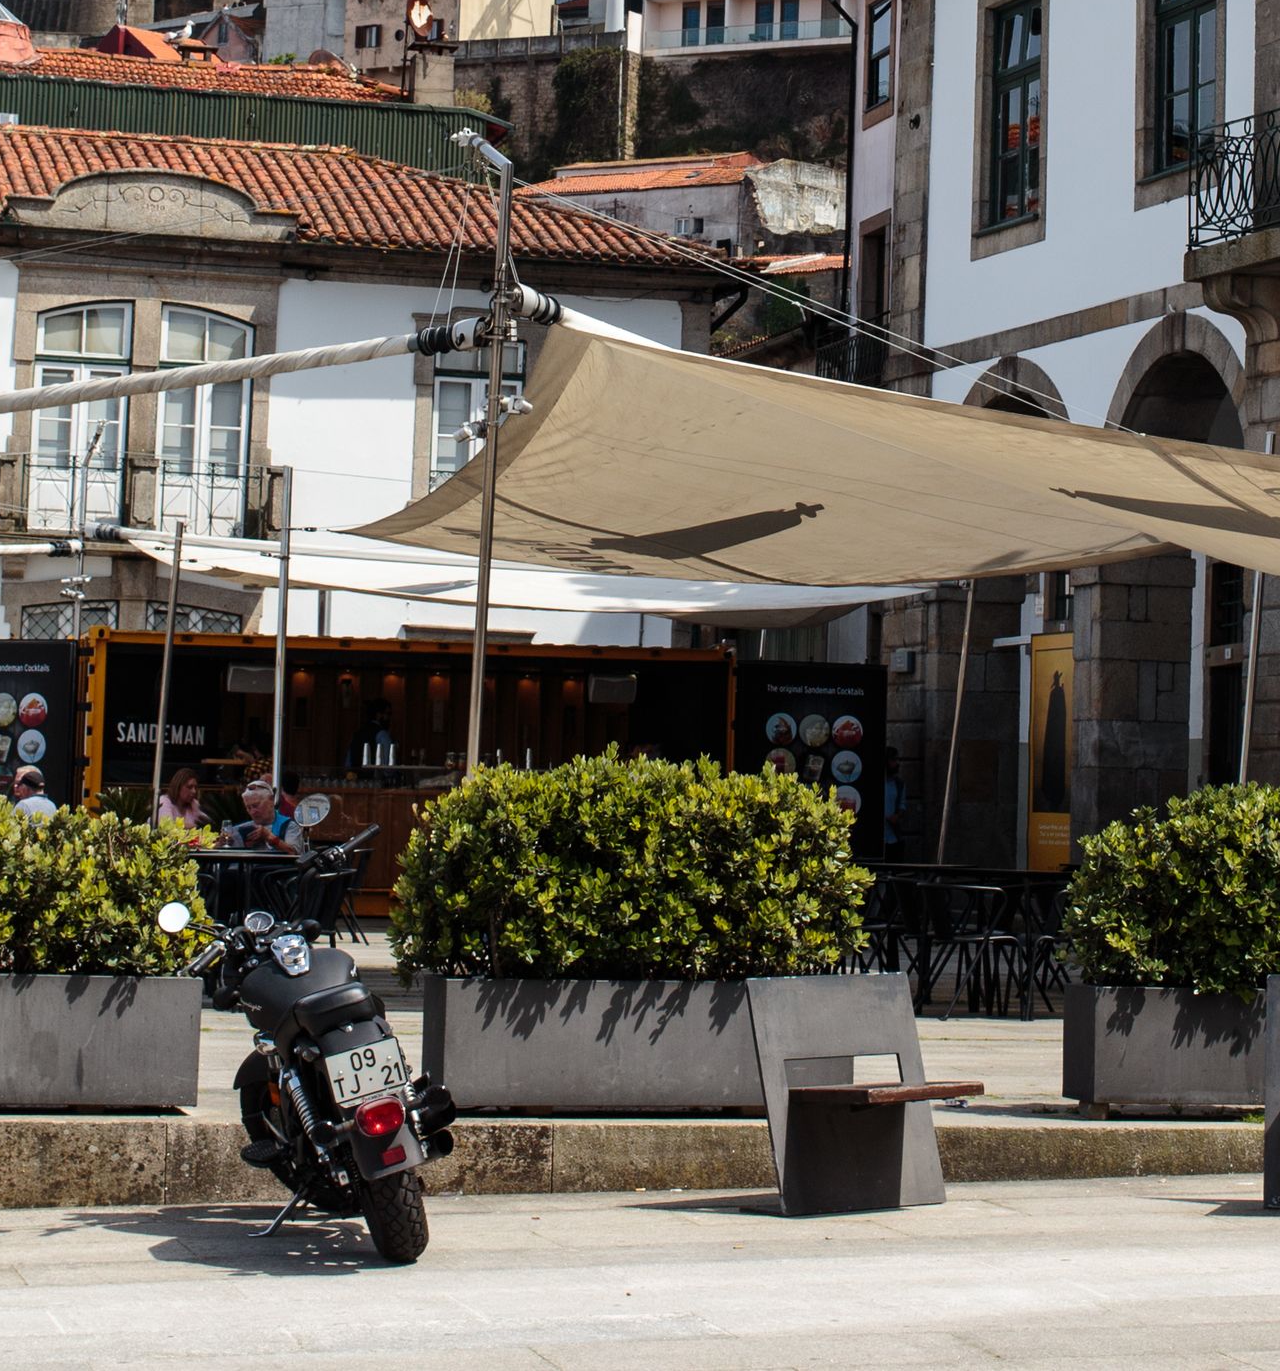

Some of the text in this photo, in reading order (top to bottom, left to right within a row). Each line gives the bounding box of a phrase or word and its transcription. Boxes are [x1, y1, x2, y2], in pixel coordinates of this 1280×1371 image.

[24, 663, 50, 673] Cocktails
[767, 684, 865, 696] The original Sandeman Cocktails
[117, 721, 205, 746] SANDEMAN
[350, 1048, 376, 1071] 09
[333, 1074, 361, 1098] TJ
[381, 1062, 403, 1085] 21
